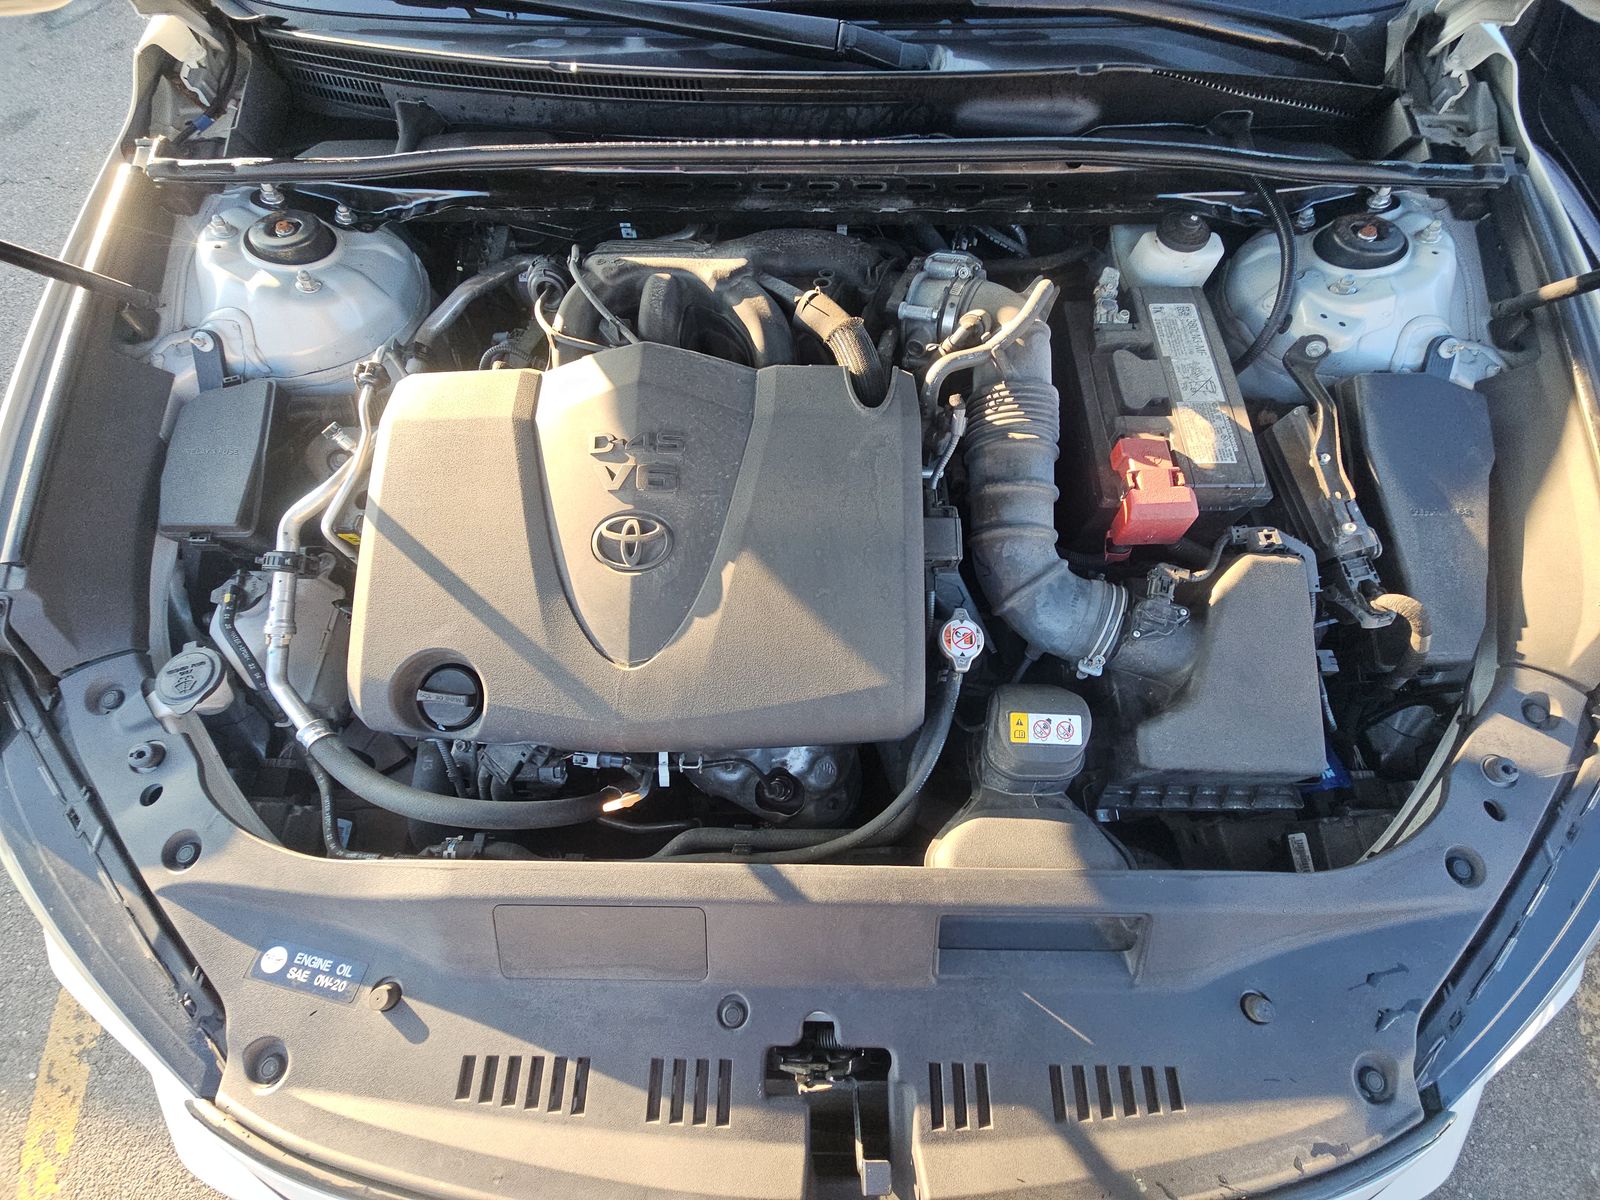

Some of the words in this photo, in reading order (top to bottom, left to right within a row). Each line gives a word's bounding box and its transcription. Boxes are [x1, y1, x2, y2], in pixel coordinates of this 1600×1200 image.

[593, 464, 679, 491] V6
[294, 953, 333, 971] ENGINE
[336, 964, 352, 977] OIL
[287, 967, 311, 982] SAE
[314, 975, 347, 992] 0W-20
